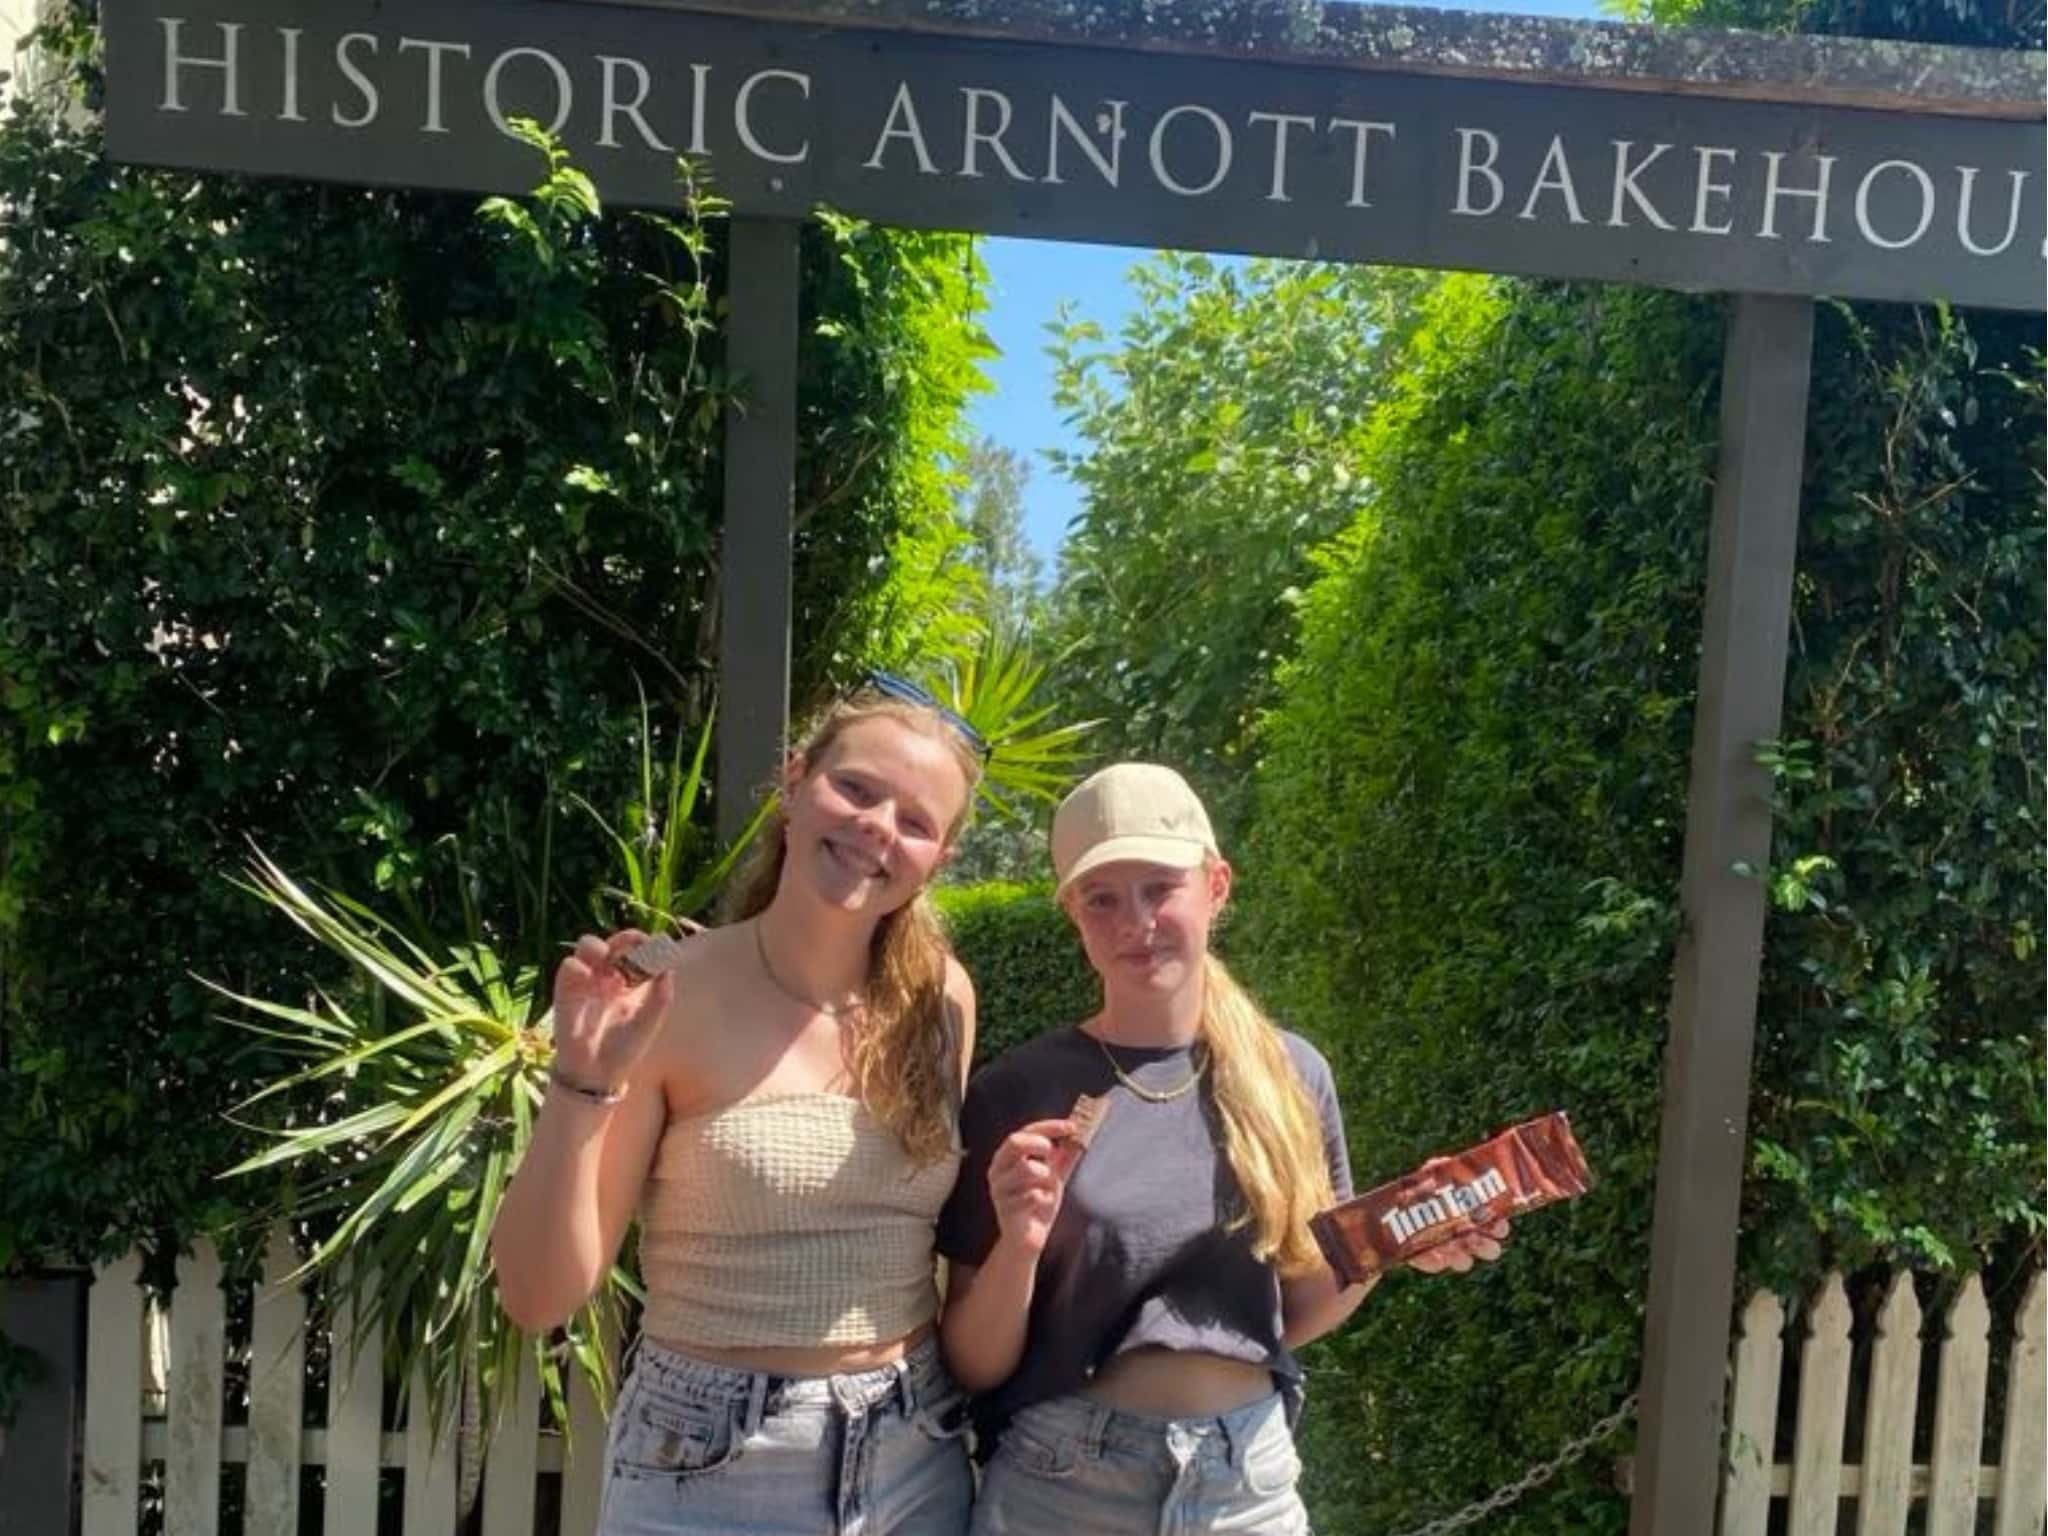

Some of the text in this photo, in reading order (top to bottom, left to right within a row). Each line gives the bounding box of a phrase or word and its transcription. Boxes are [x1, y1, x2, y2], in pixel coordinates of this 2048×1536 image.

[156, 17, 2047, 258] HISTORIC ARNOTT BAKEHOU
